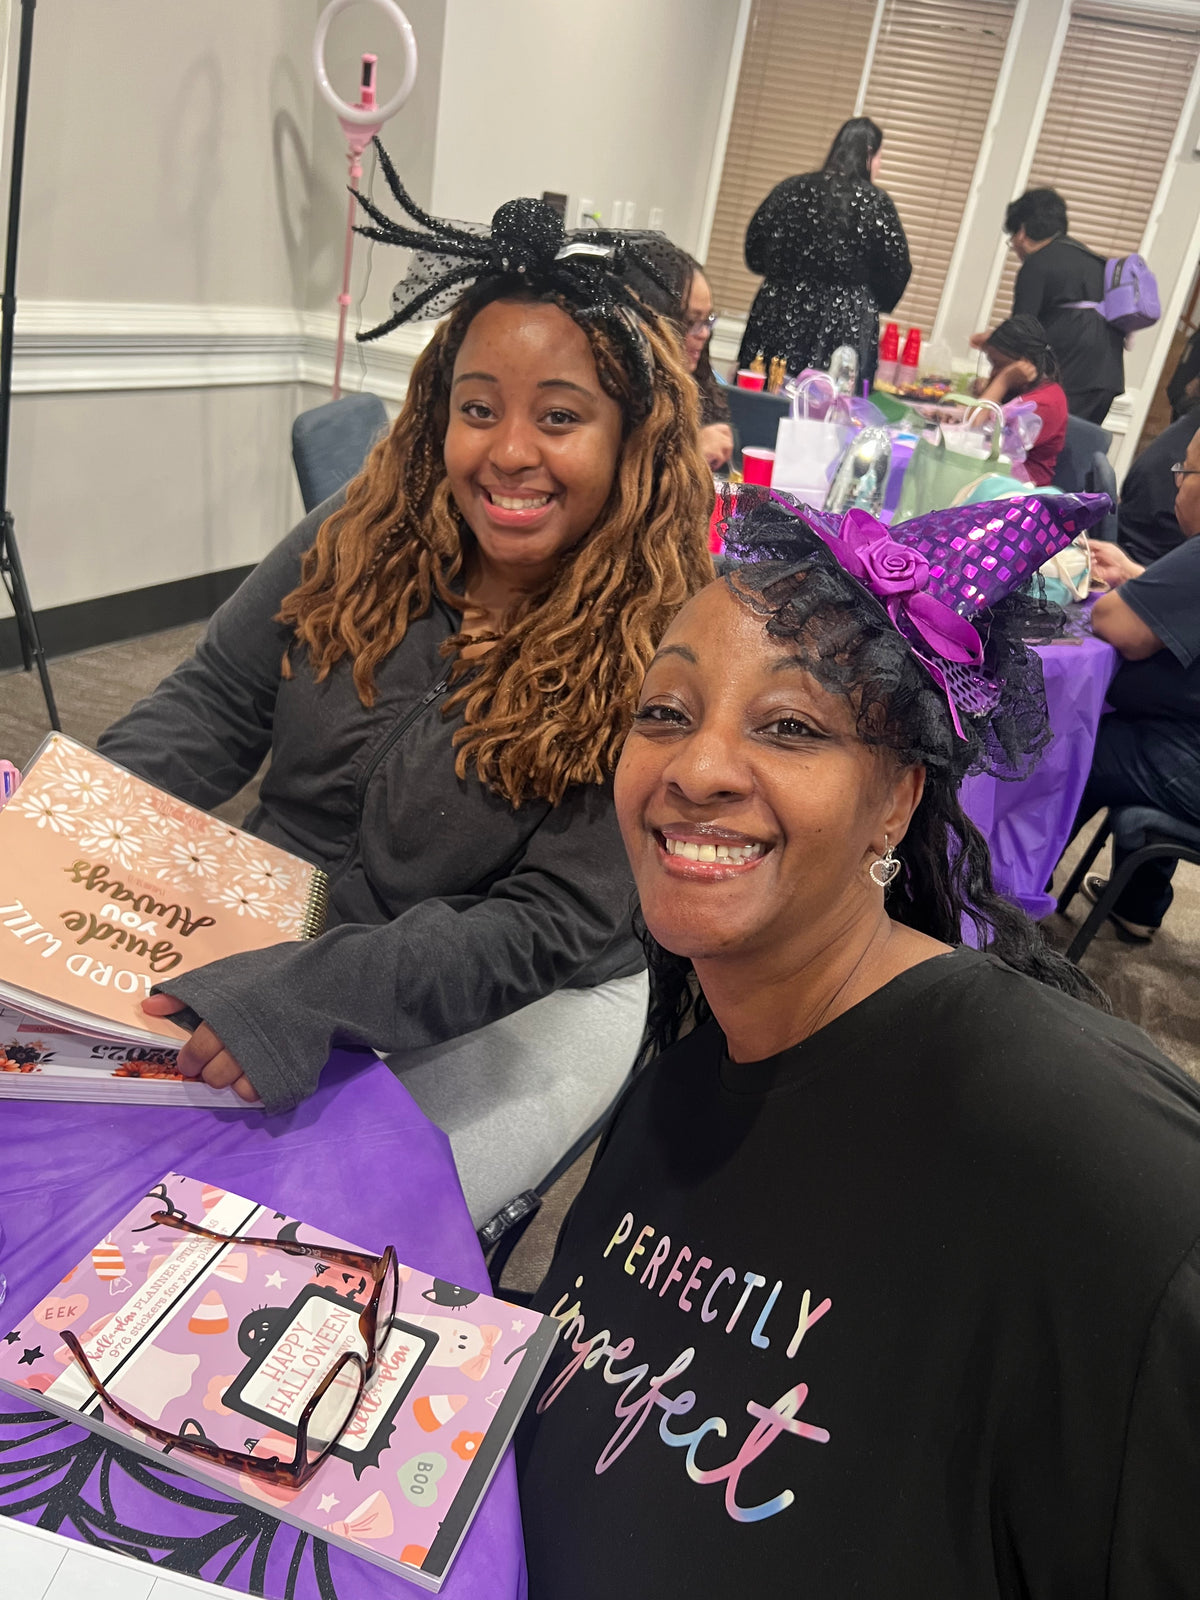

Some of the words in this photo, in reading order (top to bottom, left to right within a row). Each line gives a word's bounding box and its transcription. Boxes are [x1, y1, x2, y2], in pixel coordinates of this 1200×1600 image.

[64, 859, 216, 937] Always
[100, 903, 157, 937] YOU
[0, 899, 62, 959] WILL
[60, 910, 183, 973] Guide
[44, 1305, 79, 1320] EEK
[109, 1336, 132, 1358] 976
[130, 1297, 168, 1336] stickers
[164, 1281, 182, 1298] for
[178, 1260, 199, 1284] your
[133, 1263, 181, 1310] PLANNER
[603, 1212, 832, 1359] PERFECTLY
[260, 1321, 313, 1382] HAPPY
[267, 1307, 352, 1416] HALLOWEEN
[376, 1345, 410, 1381] plan
[410, 1461, 434, 1495] BOO
